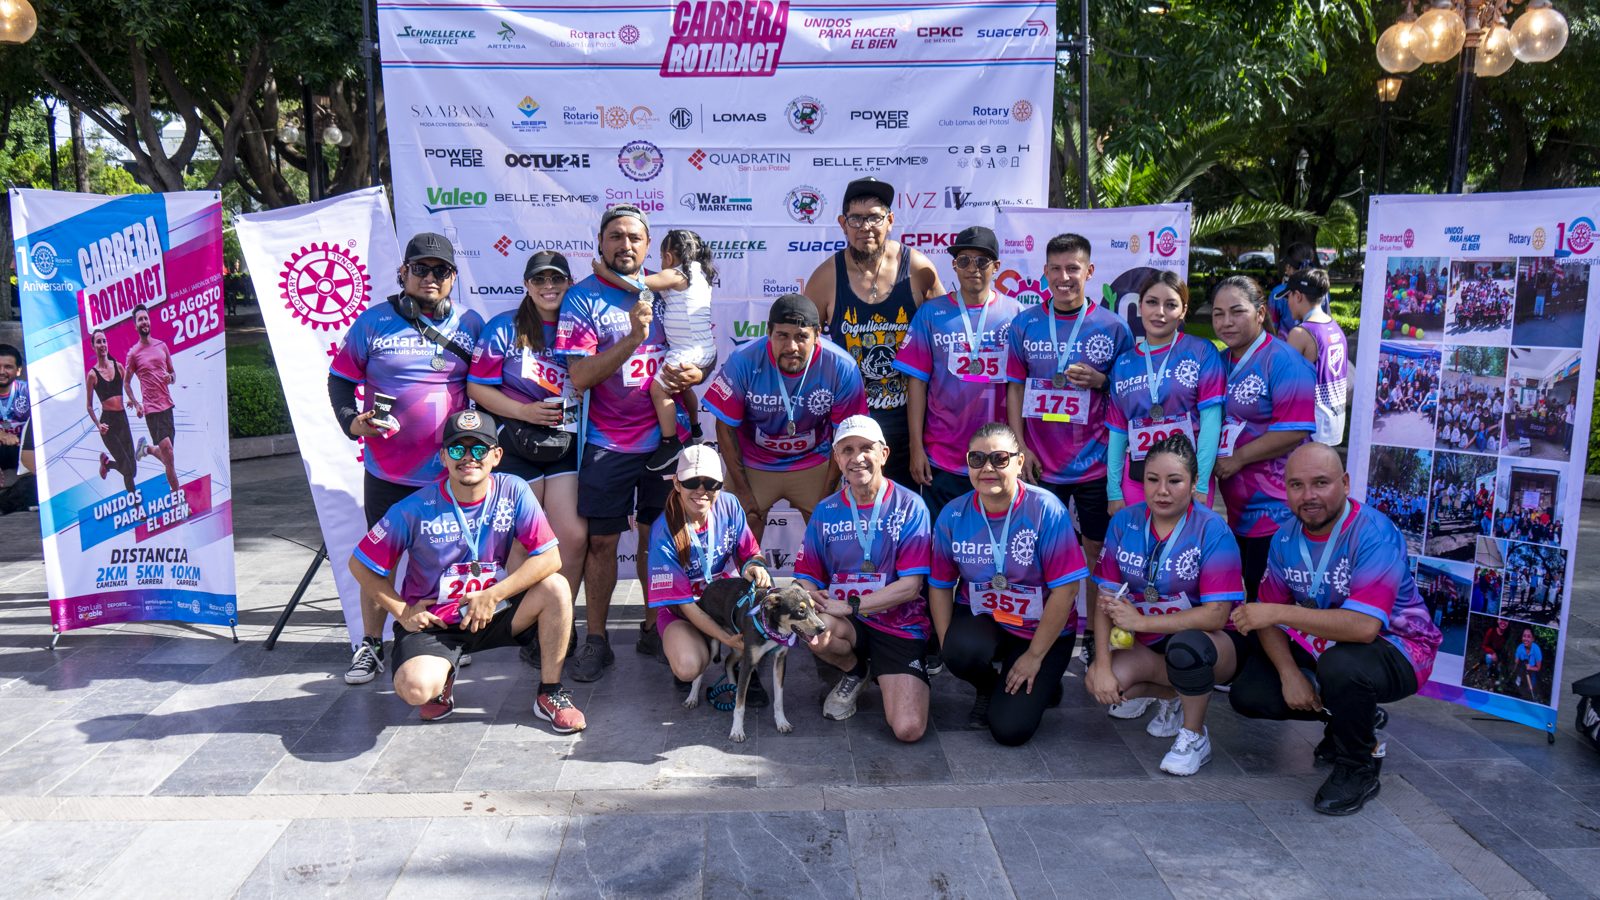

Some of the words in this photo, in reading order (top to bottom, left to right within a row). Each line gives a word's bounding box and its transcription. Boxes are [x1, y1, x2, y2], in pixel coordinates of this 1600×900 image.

[673, 0, 790, 38] CARRERA
[804, 18, 852, 28] UNIDOS
[397, 25, 476, 38] SCHNELLECKE
[570, 30, 615, 39] Rotaract
[818, 28, 852, 38] PARA
[854, 27, 896, 38] HACER
[917, 26, 963, 37] CPKC
[977, 27, 1038, 38] suacero
[549, 40, 566, 48] Club
[851, 39, 866, 49] EL
[867, 38, 898, 49] BIEN
[667, 42, 780, 73] ROTARACT
[410, 104, 495, 118] SAABANA
[563, 112, 599, 120] Rotario
[850, 110, 909, 121] POWER
[973, 106, 1009, 118] Rotary
[671, 109, 692, 129] MG
[712, 113, 767, 122] LOMAS
[938, 119, 954, 127] Club
[425, 148, 483, 158] POWER
[948, 144, 1007, 154] casa
[1018, 144, 1030, 153] H
[709, 152, 791, 165] QUADRATIN
[813, 157, 862, 167] BELLE
[426, 187, 488, 206] Valeo
[494, 193, 543, 203] BELLE
[605, 188, 633, 200] San
[635, 188, 664, 200] Luis
[696, 193, 728, 204] War
[699, 204, 753, 212] MARKETING
[1444, 226, 1464, 234] UNIDOS
[1004, 239, 1025, 248] Rotaract
[1379, 233, 1403, 243] Rotaract
[1449, 235, 1463, 243] PARA
[1463, 234, 1481, 242] HACER
[1508, 233, 1531, 246] Rotary
[514, 239, 594, 252] QUADRATIN
[787, 240, 848, 252] suace
[1110, 239, 1128, 250] Rotary
[1461, 243, 1468, 251] EL
[1468, 243, 1480, 251] BIEN
[78, 216, 161, 286] CARRERA
[1147, 258, 1186, 266] Aniversario
[23, 280, 74, 292] Aniversario
[332, 252, 362, 312] INTERNATIONAL
[288, 275, 306, 312] ROTARY
[470, 286, 525, 295] LOMAS
[763, 284, 799, 293] Rotario
[88, 263, 163, 328] ROTARACT
[160, 304, 177, 322] 03
[179, 285, 221, 316] AGOSTO
[172, 303, 220, 346] 2025
[841, 320, 909, 338] Orgullosamen
[394, 348, 410, 356] Luis
[1132, 384, 1146, 394] Luis
[763, 404, 777, 413] Luis
[1034, 394, 1080, 416] 175
[764, 439, 808, 451] 209
[93, 489, 143, 520] UNIDOS
[113, 507, 147, 530] PARA
[148, 489, 186, 515] HACER
[147, 516, 161, 533] EL
[162, 503, 189, 525] BIEN
[429, 536, 444, 544] San
[840, 533, 854, 541] Luis
[110, 548, 188, 564] DISTANCIA
[962, 556, 976, 564] Luis
[96, 566, 128, 582] 2KM
[135, 565, 164, 579] 5KM
[170, 565, 201, 581] 10KM
[1127, 566, 1140, 578] Luis
[96, 580, 128, 589] CAMINATA
[137, 578, 163, 586] CARRERA
[176, 579, 198, 587] CARRERA
[981, 592, 1031, 615] 357
